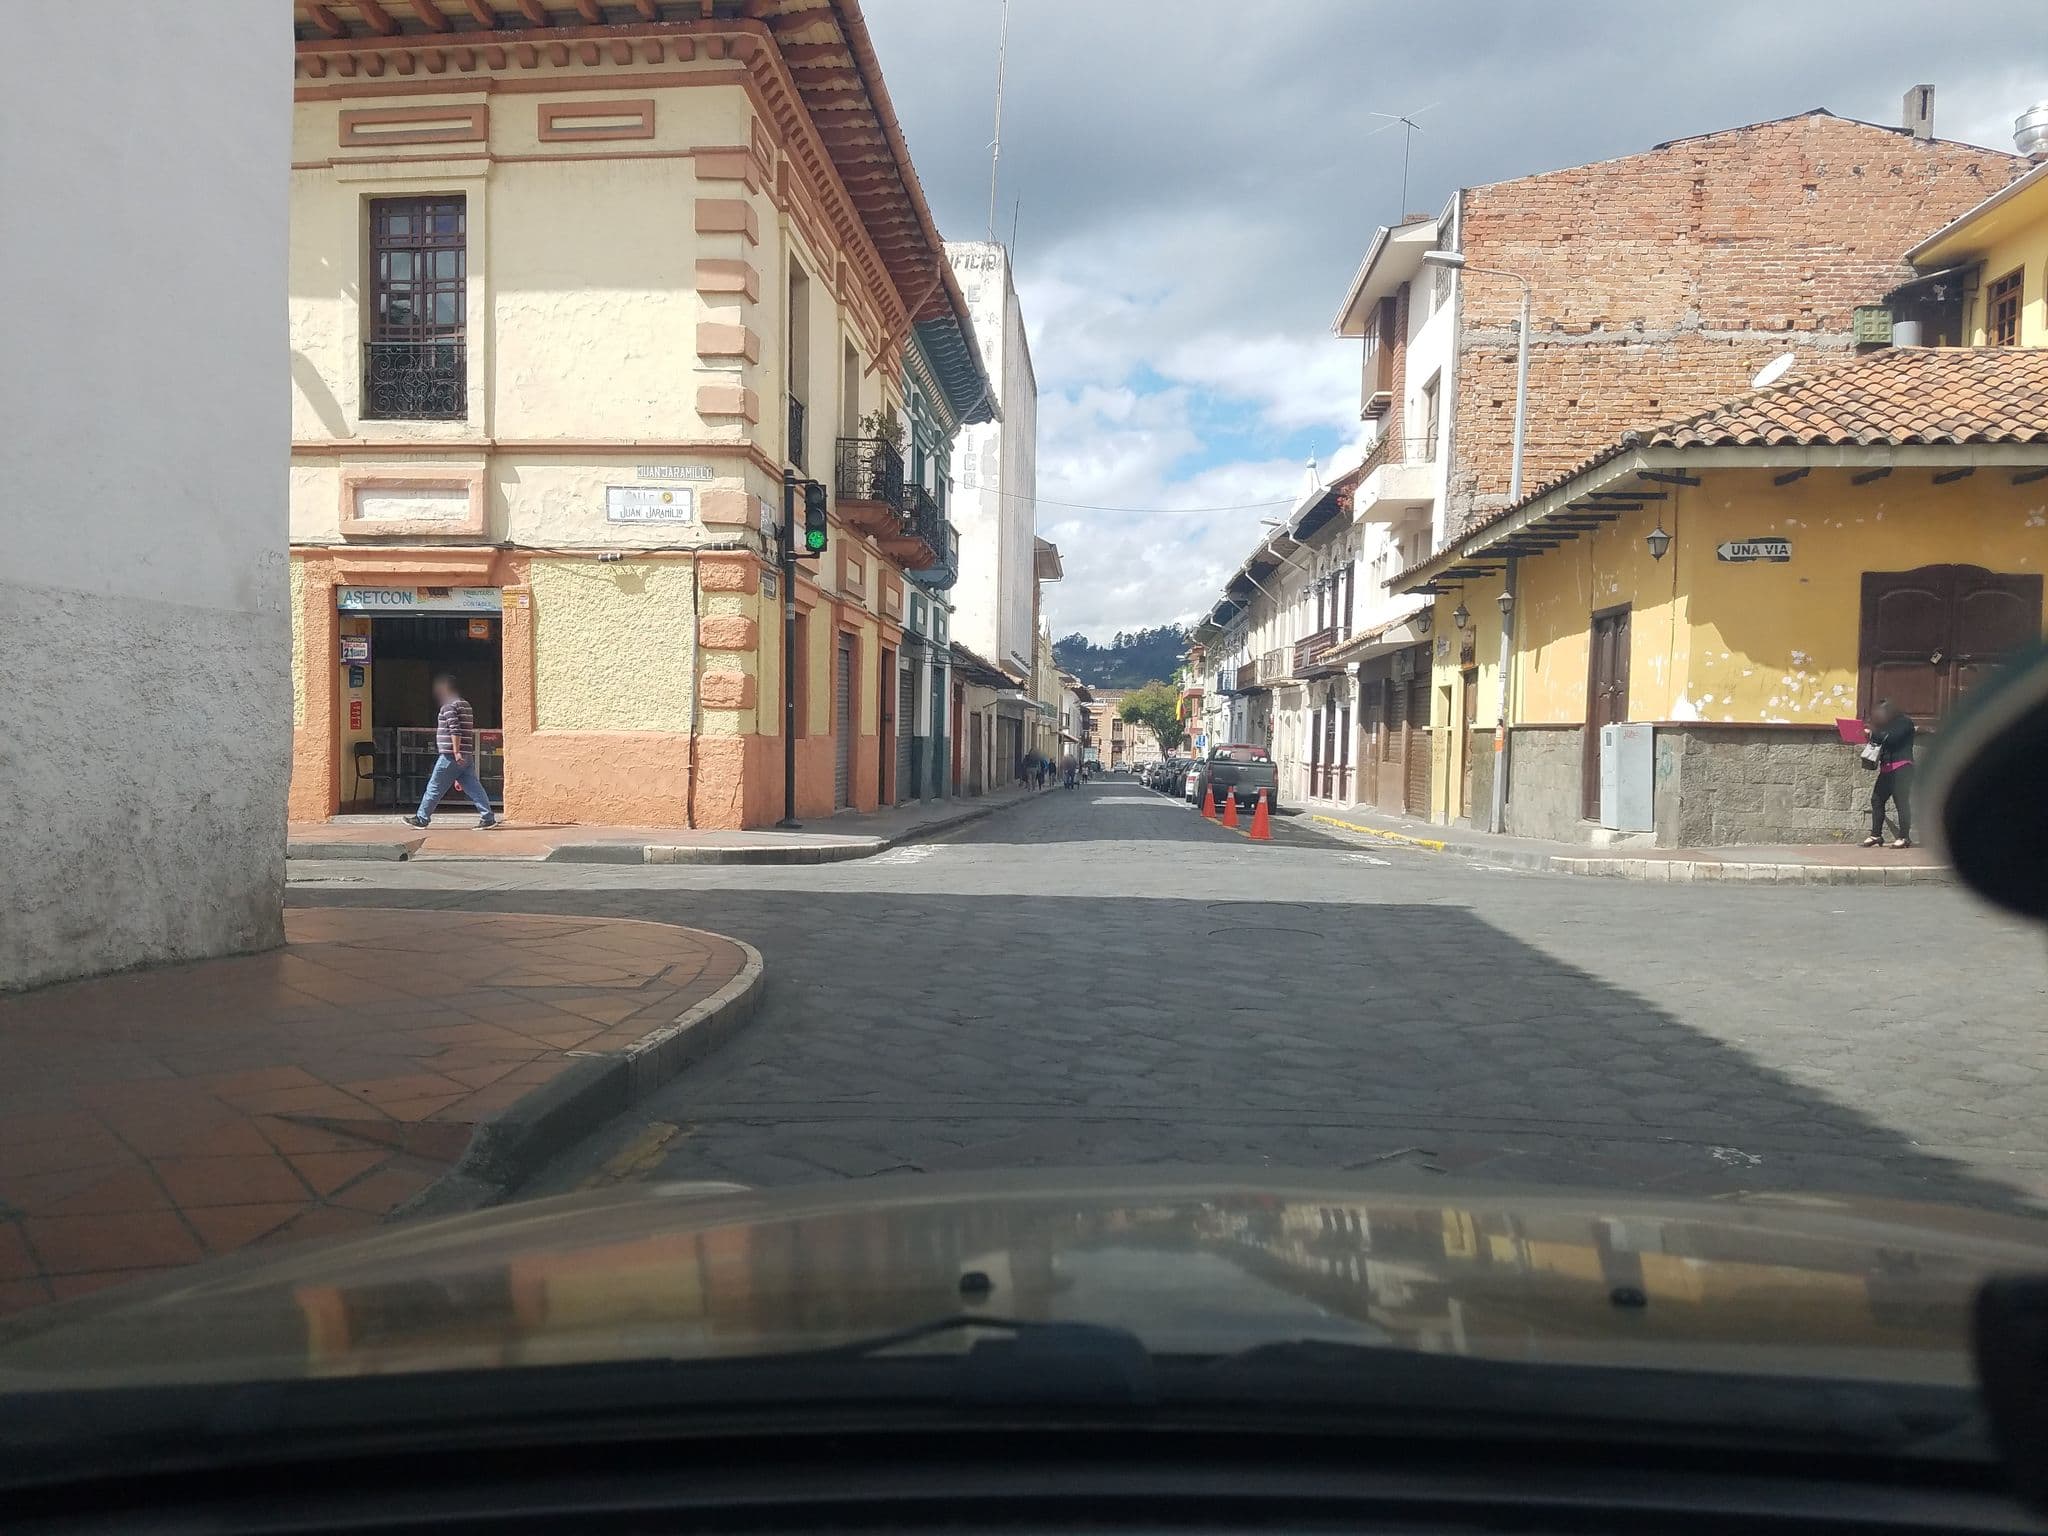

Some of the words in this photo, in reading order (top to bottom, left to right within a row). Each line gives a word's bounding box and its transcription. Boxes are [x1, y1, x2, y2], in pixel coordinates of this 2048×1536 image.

[638, 465, 661, 478] JUAN
[662, 466, 713, 479] JARAMILLO
[620, 506, 641, 518] JUAN
[1731, 544, 1760, 555] UNA
[1764, 544, 1788, 555] VIA
[344, 591, 412, 605] ASETCON
